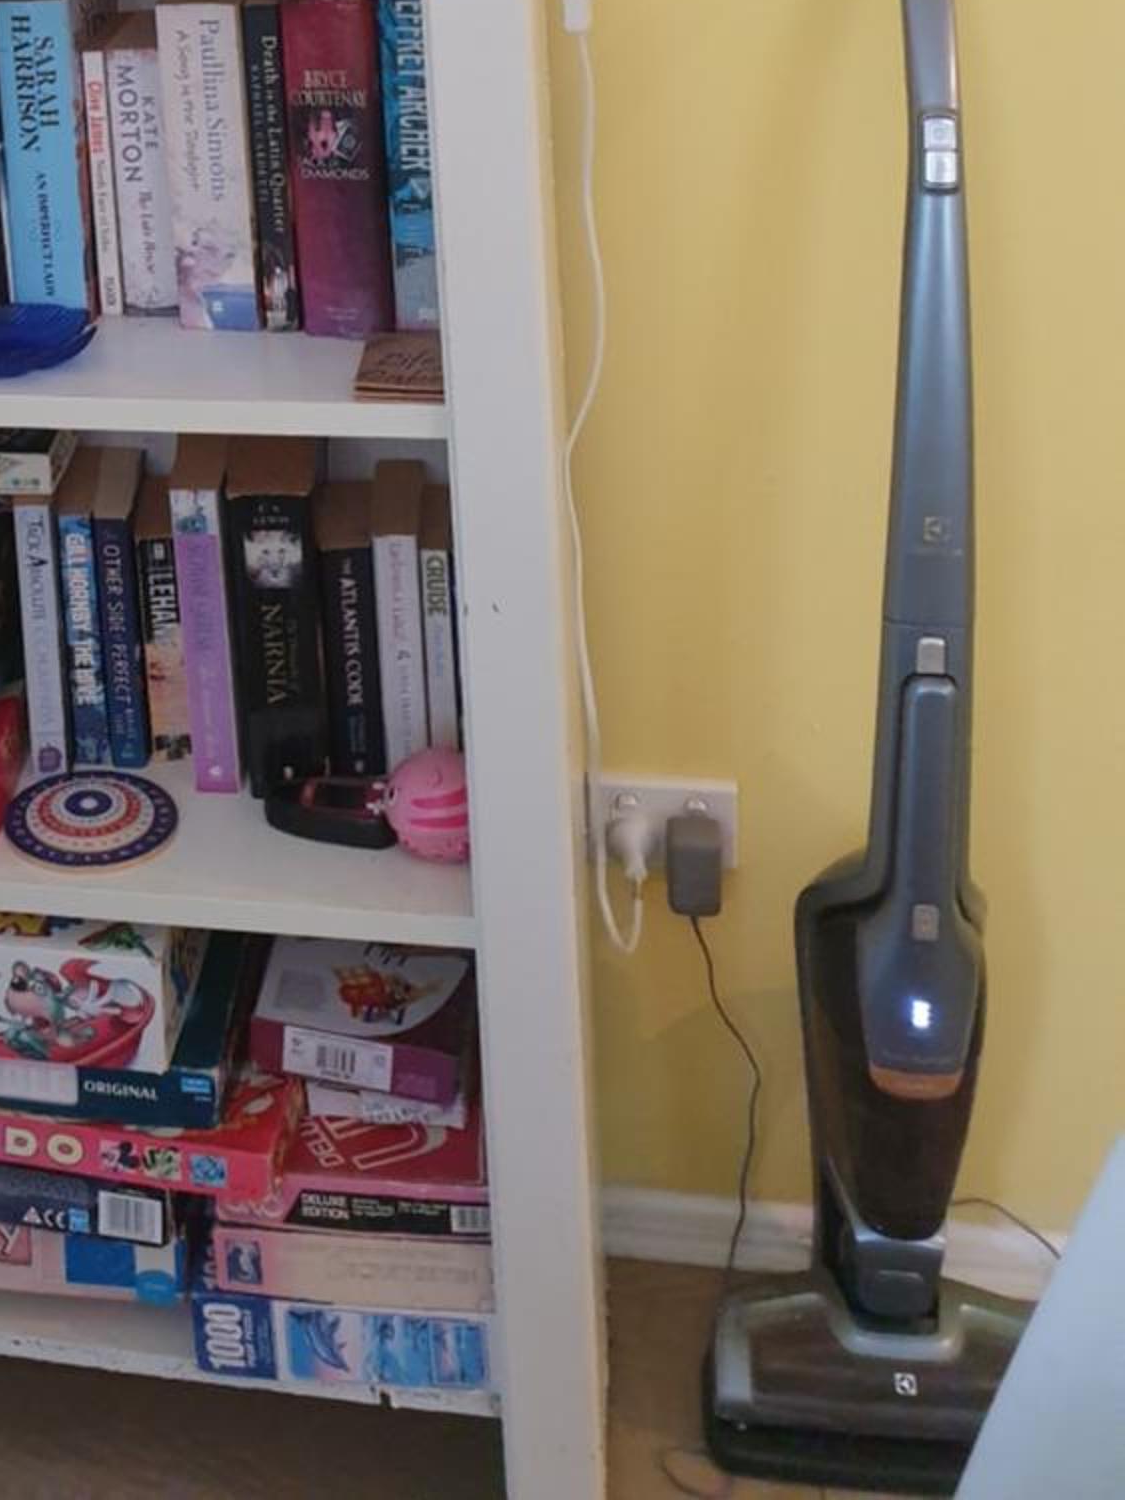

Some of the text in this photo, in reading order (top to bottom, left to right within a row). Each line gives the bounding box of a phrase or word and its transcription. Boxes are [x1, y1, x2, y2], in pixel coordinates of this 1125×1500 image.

[10, 14, 43, 155] HARRISON
[33, 35, 61, 129] SARAH
[260, 35, 280, 86] Death
[115, 63, 144, 184] MORTON
[140, 94, 161, 151] KATE
[198, 18, 231, 203] Paullina Simons
[396, 81, 432, 172] ARCHER
[268, 125, 286, 171] Latin
[270, 173, 287, 234] Quarter
[65, 532, 86, 566] GILL
[101, 543, 124, 596] OTHER
[67, 569, 92, 632] HORNBY
[106, 601, 128, 635] SIDE
[146, 570, 179, 646] LEHAN
[338, 578, 363, 653] ATLANTIS
[110, 643, 133, 704] PERFECT
[261, 603, 289, 706] NARNIA
[342, 653, 364, 708] CODE
[84, 1079, 158, 1101] ORIGINAL
[300, 1206, 350, 1219] EDITION
[301, 1193, 347, 1207] DELUXE
[203, 1302, 246, 1369] 1000
